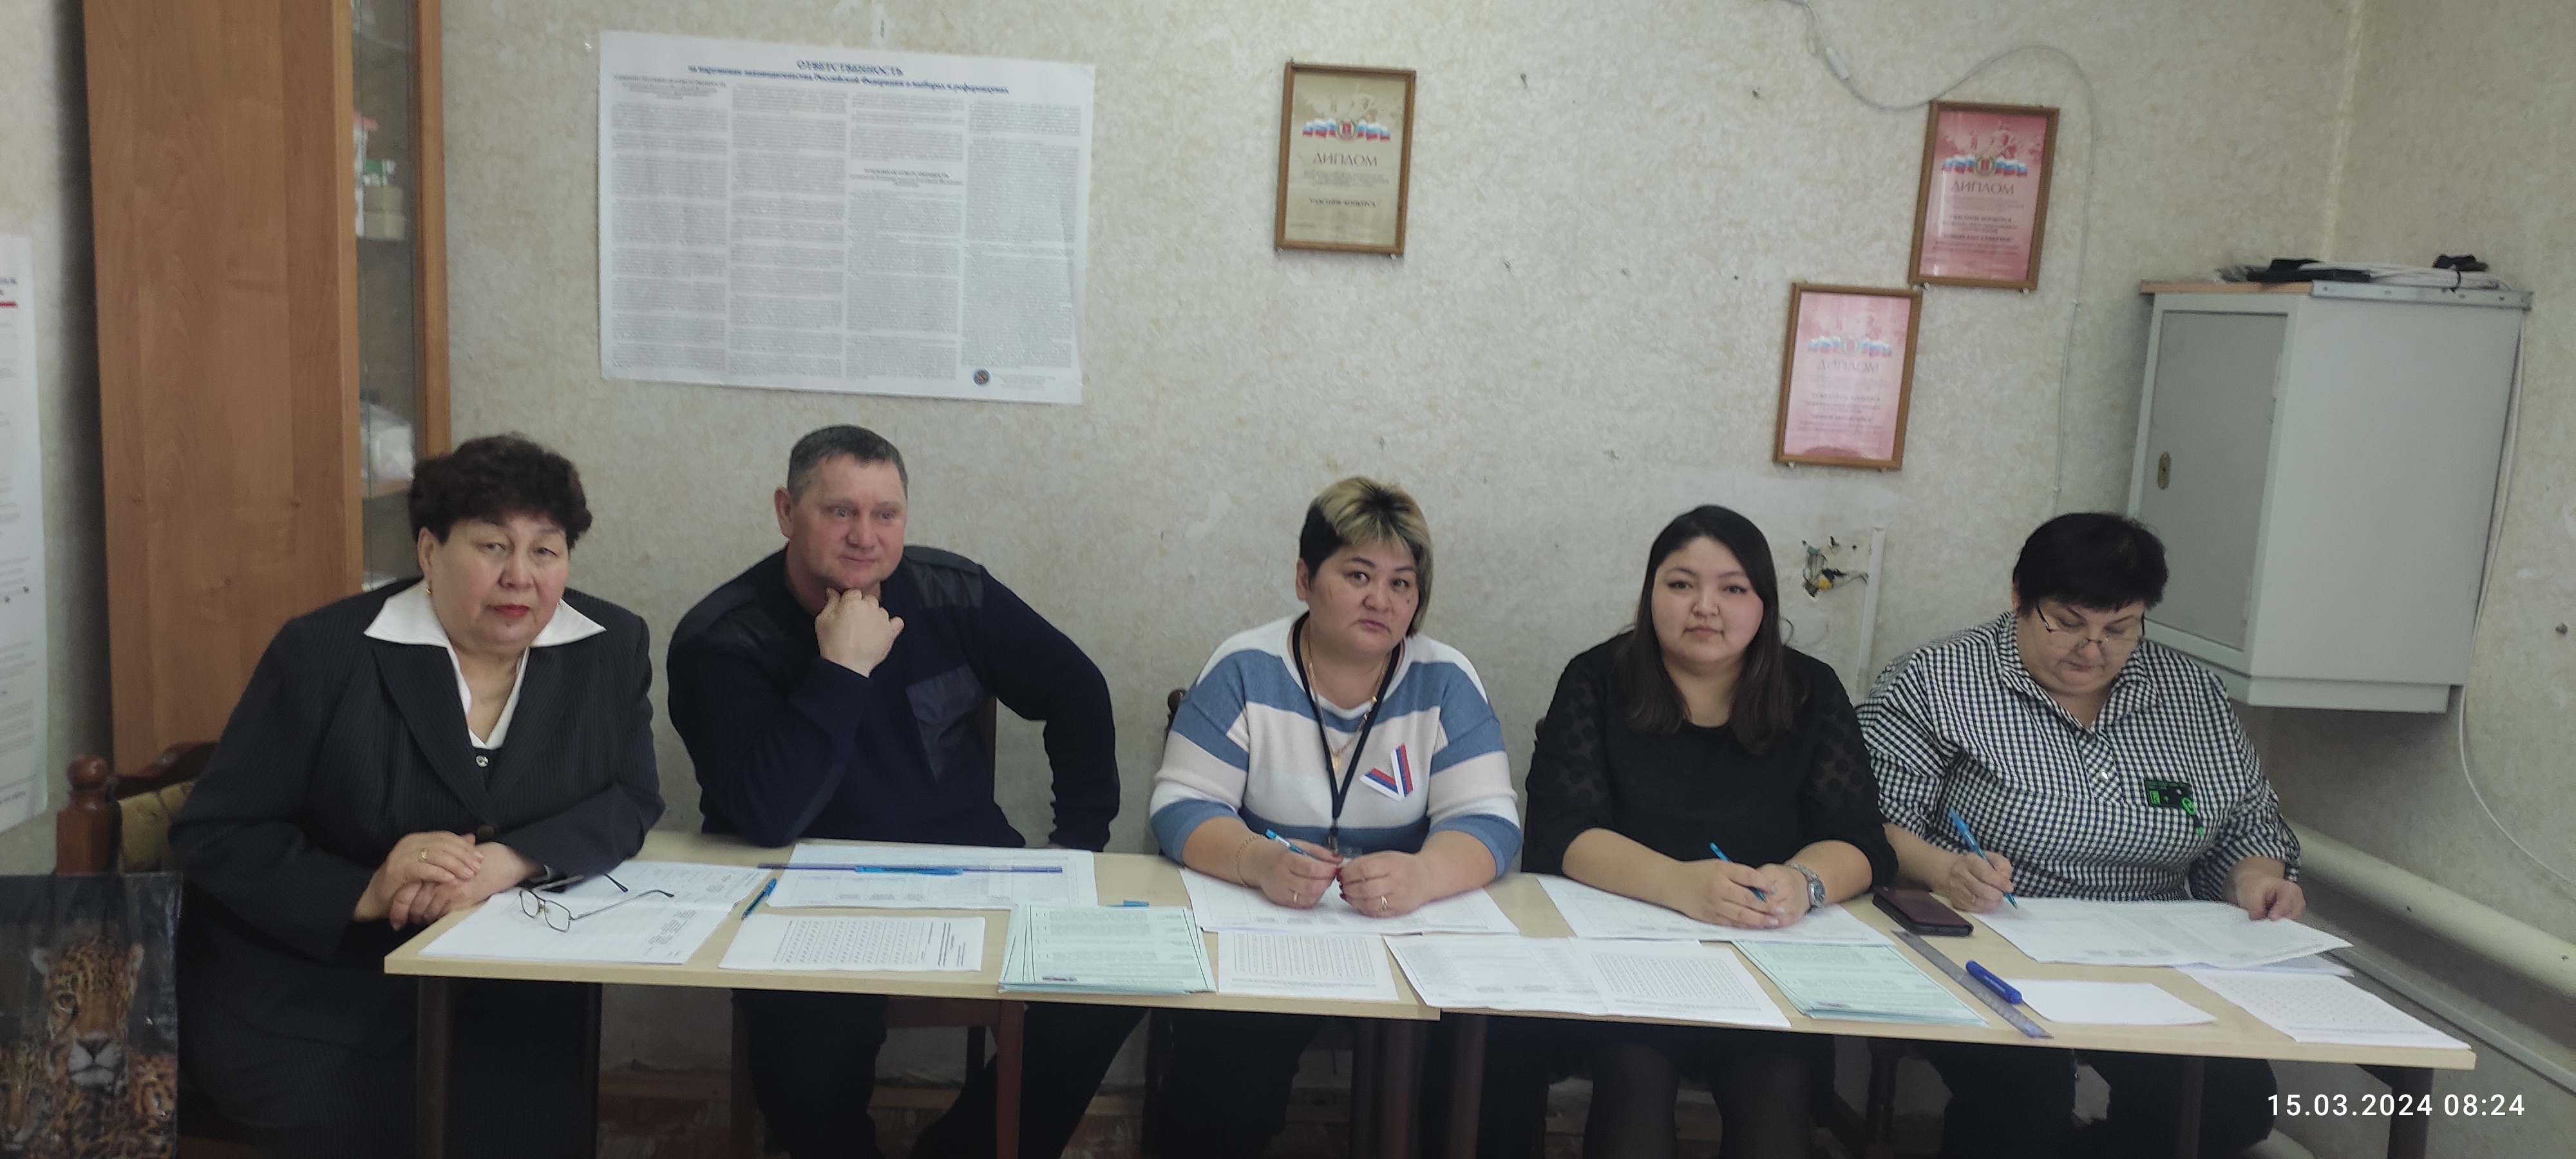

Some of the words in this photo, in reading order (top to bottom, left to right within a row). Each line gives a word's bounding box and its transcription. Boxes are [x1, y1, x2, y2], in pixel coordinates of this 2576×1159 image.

[1312, 152, 1378, 167] ДИПЛОМ
[1951, 180, 2015, 195] ДИПЛОМ
[1817, 359, 1880, 374] ДИПЛОМ
